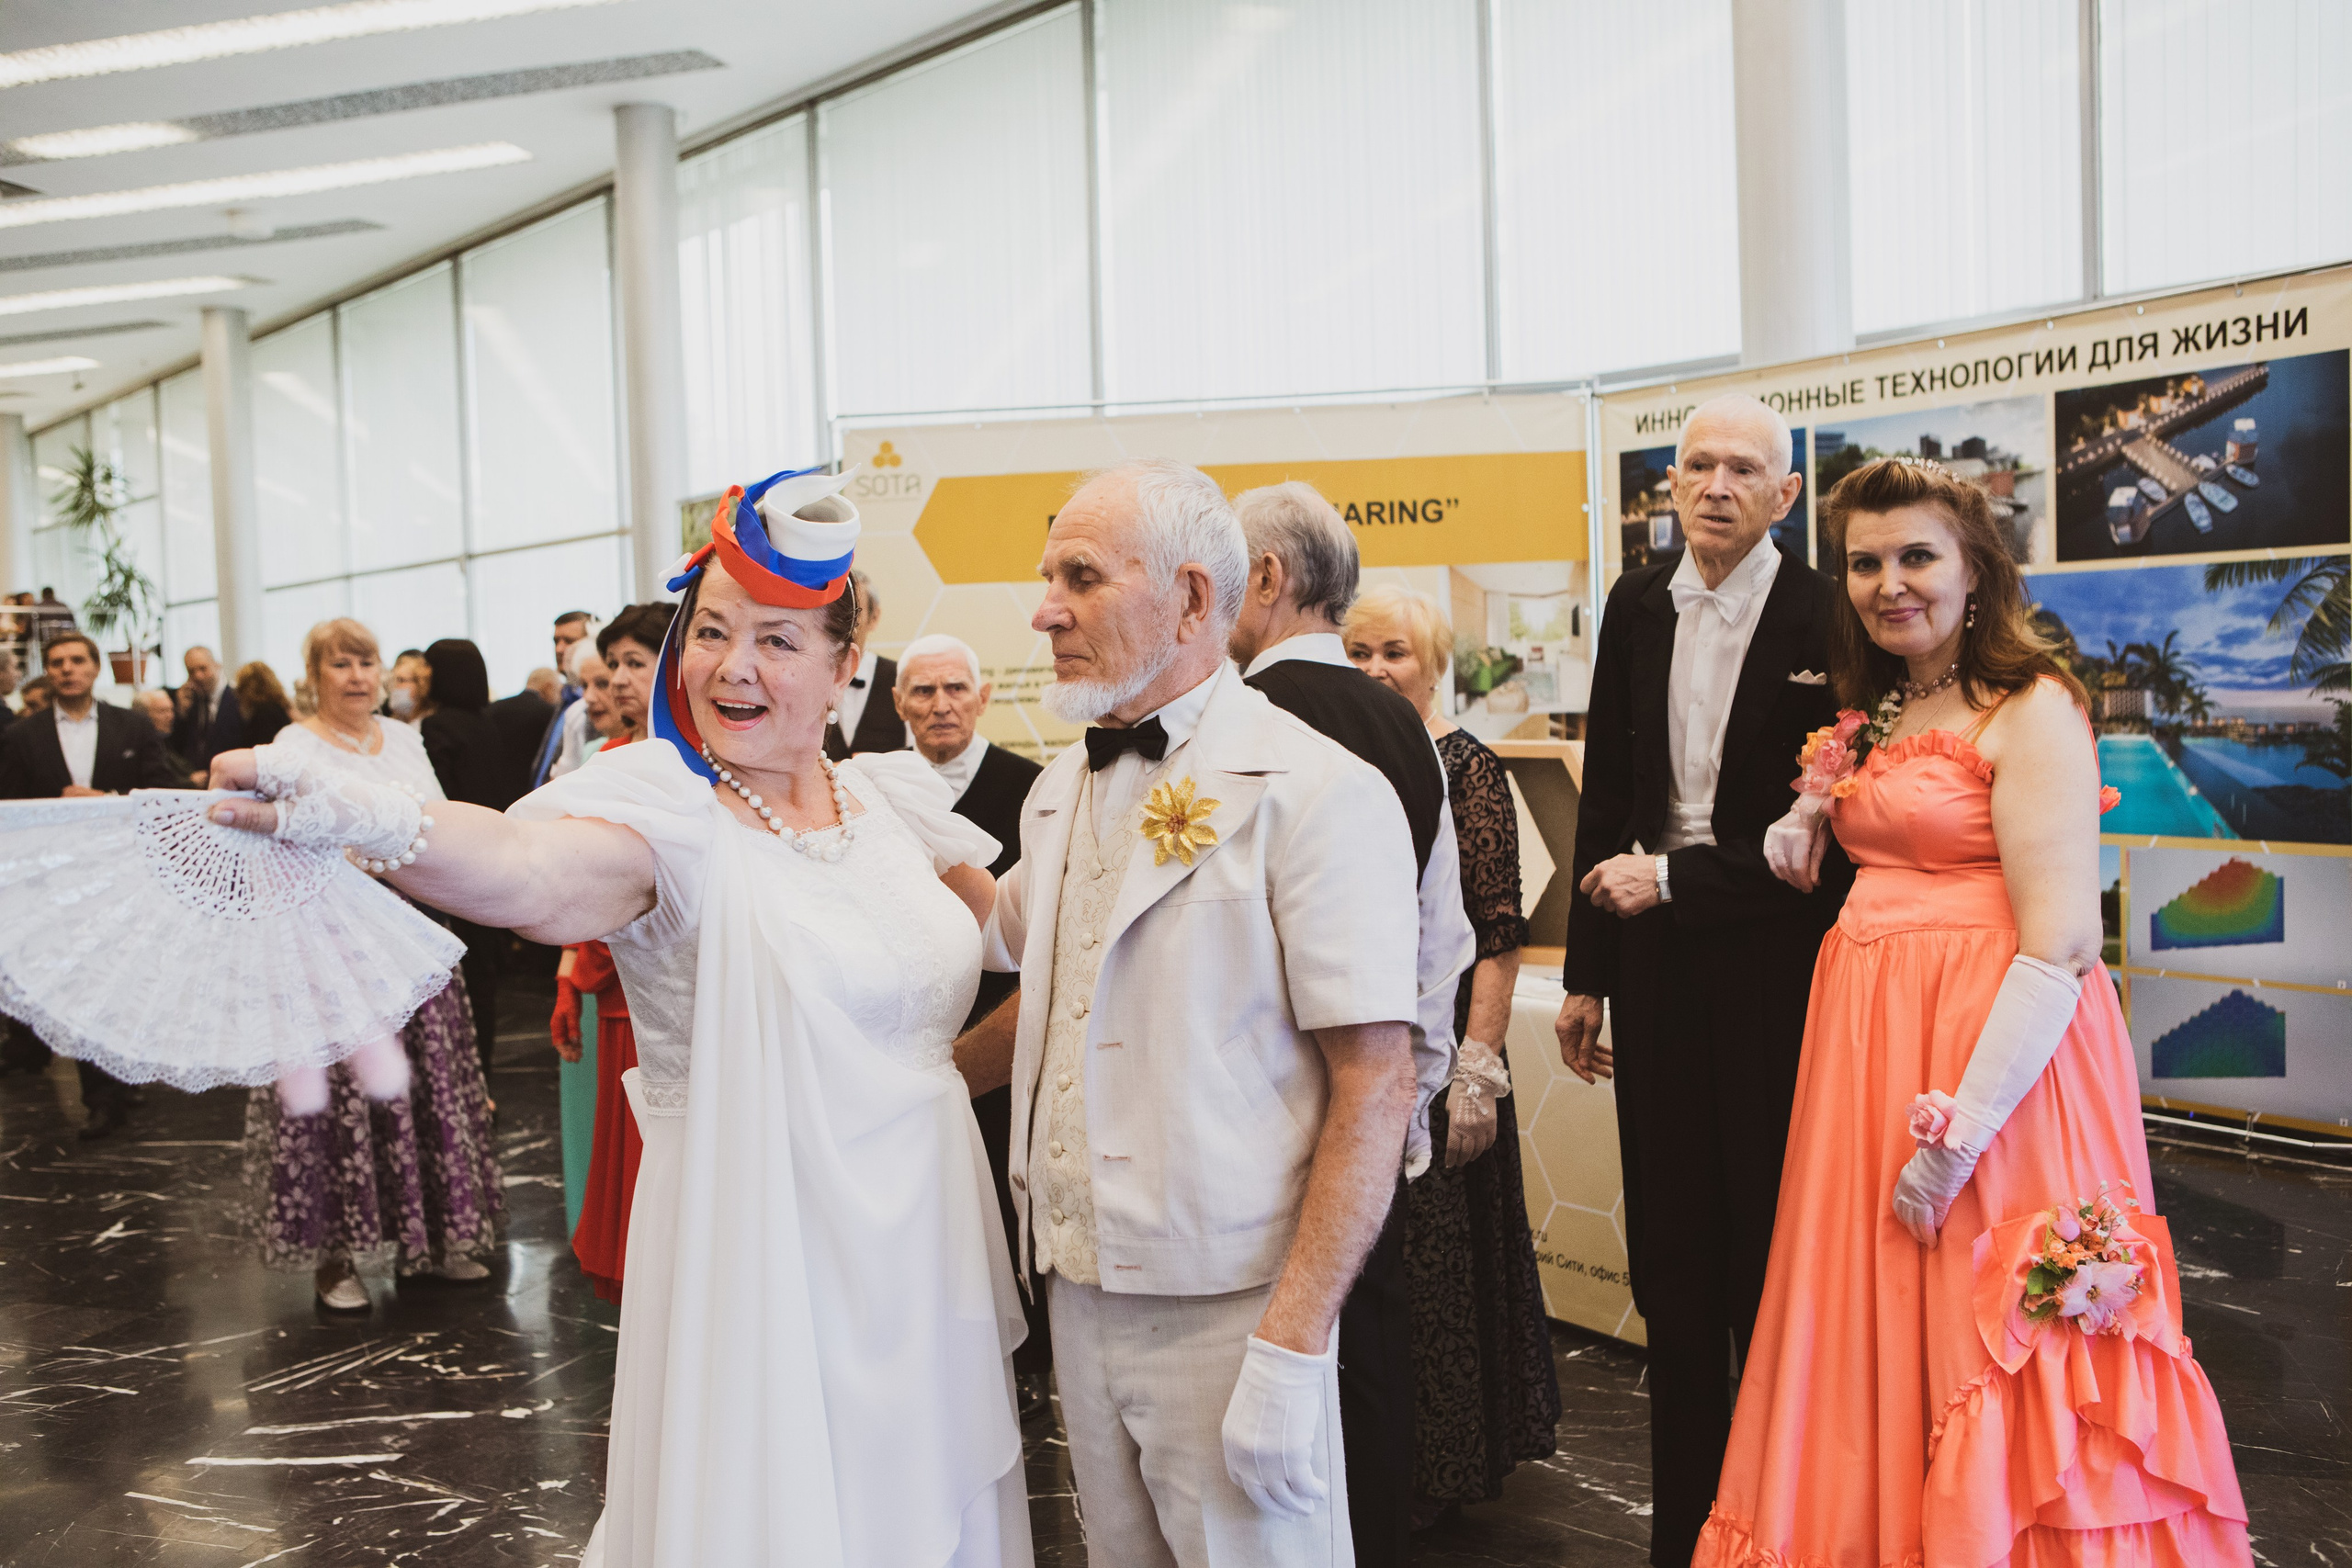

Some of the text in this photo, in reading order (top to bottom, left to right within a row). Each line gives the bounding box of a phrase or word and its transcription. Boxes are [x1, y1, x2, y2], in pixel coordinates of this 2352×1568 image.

[1875, 344, 2077, 400] ТЕХНОЛОГИИ
[2087, 332, 2159, 374] ДЛЯ
[2171, 306, 2308, 356] ЖИЗНИ
[1556, 1253, 1588, 1277] Сити,
[1590, 1265, 1621, 1283] офис
